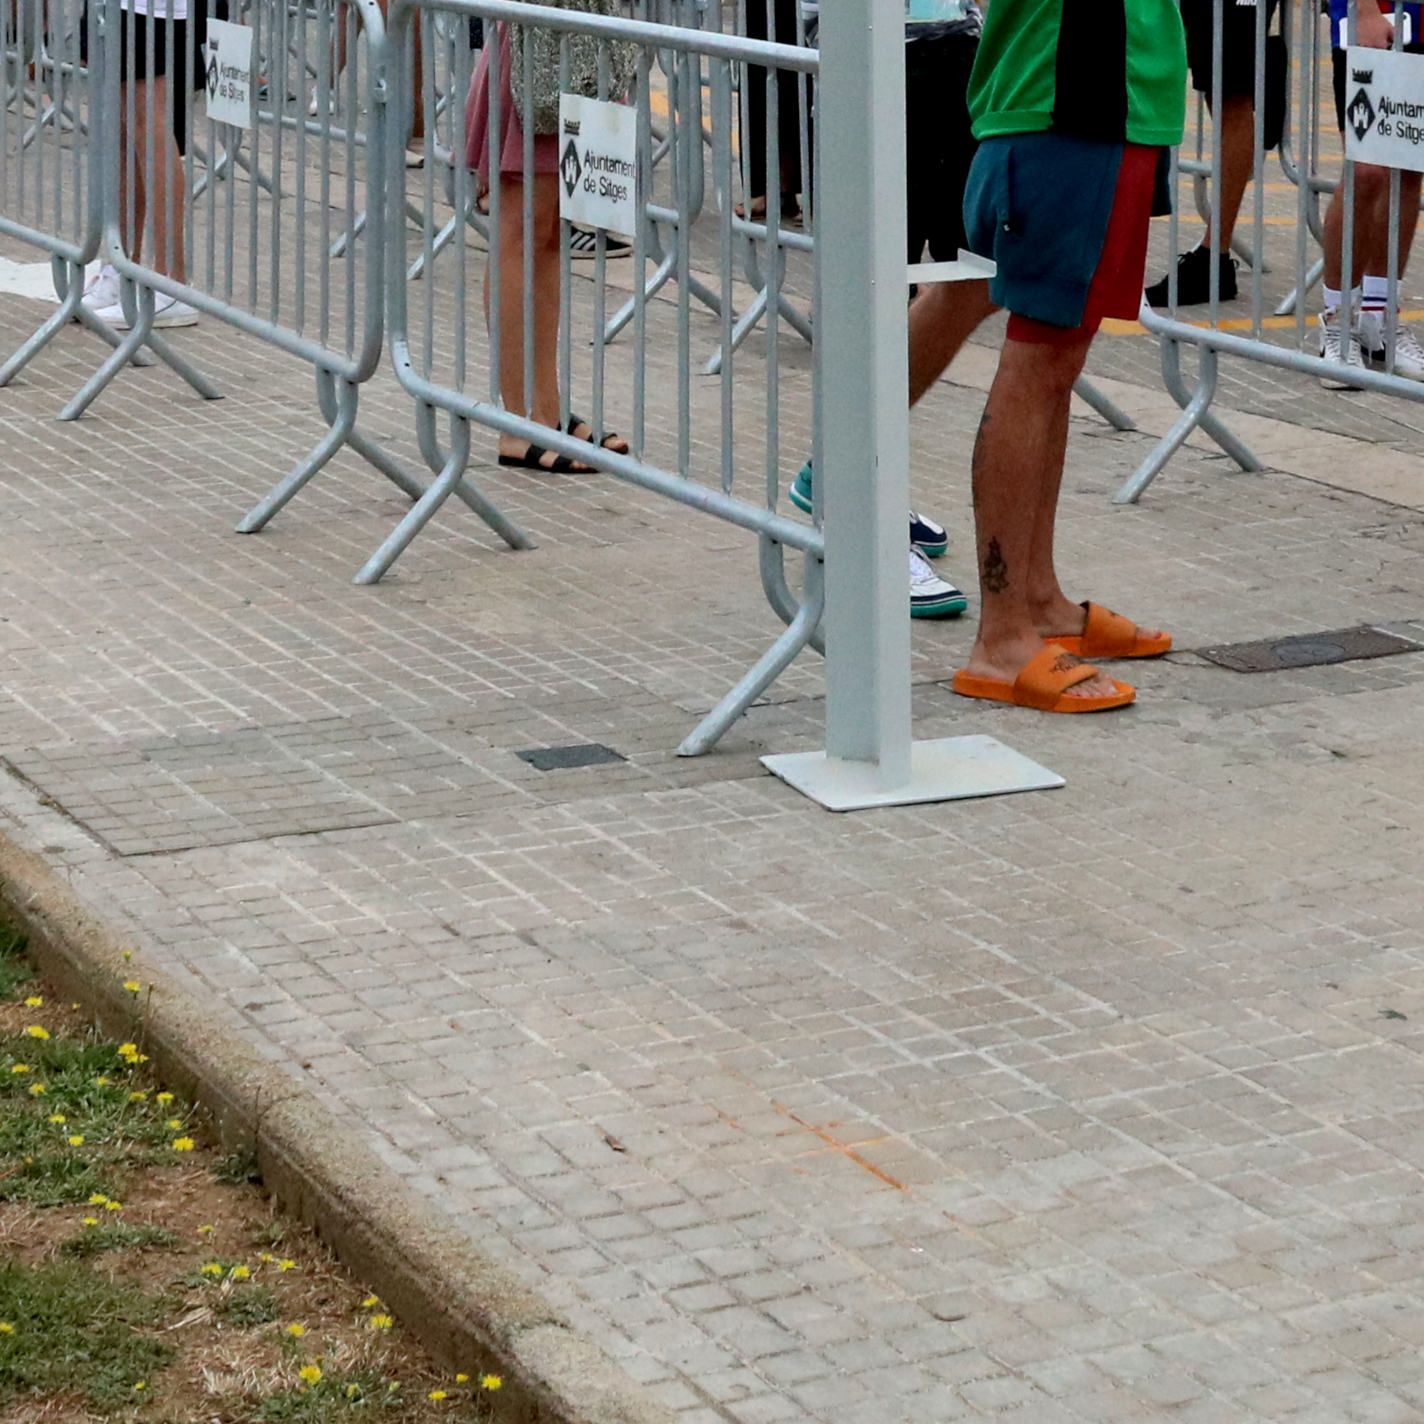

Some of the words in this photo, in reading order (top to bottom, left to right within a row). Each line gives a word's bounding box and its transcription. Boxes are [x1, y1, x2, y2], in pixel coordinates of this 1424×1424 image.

[1377, 118, 1392, 136] de
[583, 175, 596, 194] de
[599, 176, 627, 203] Sitges
